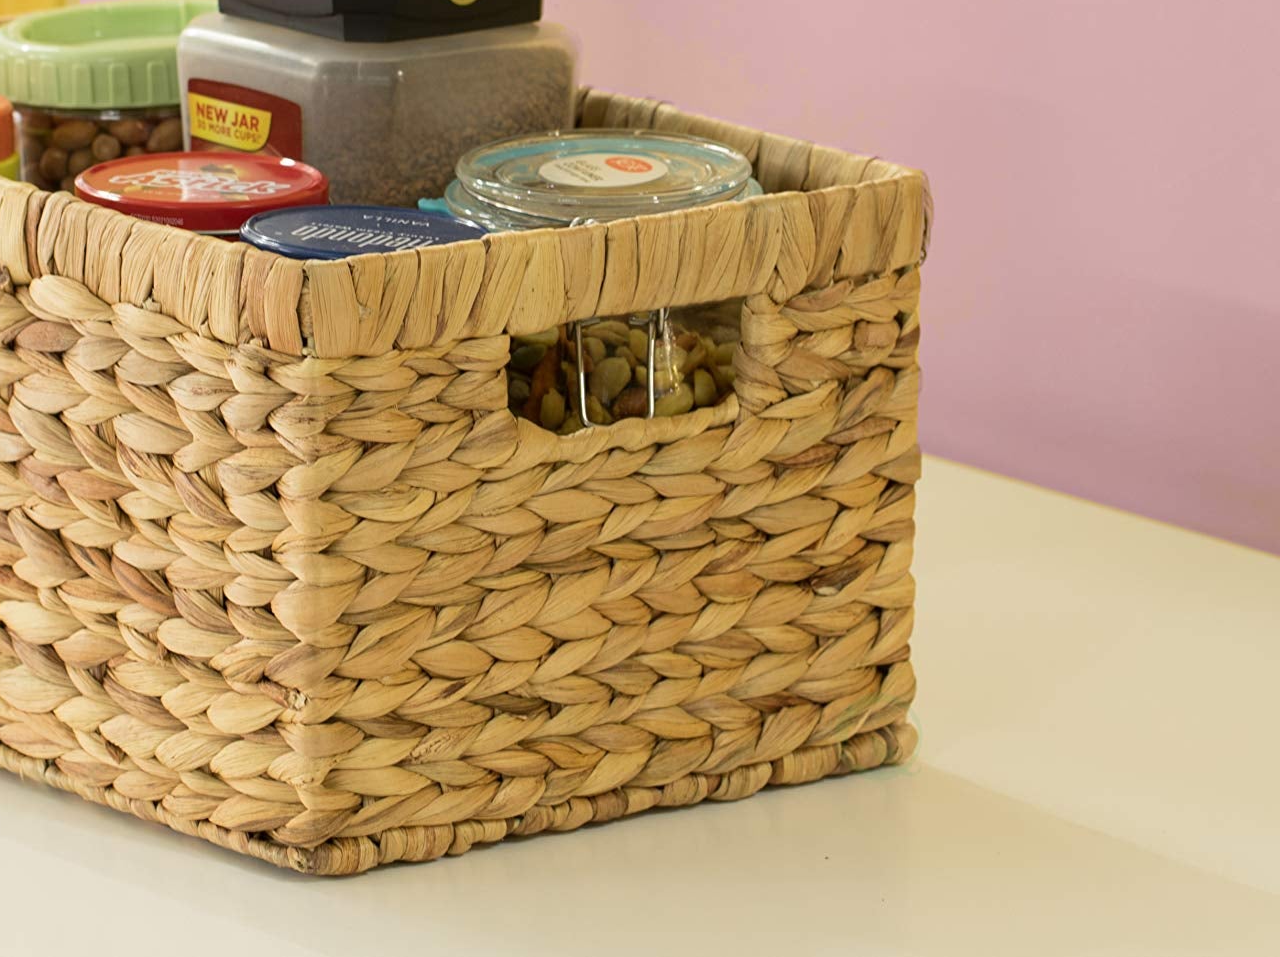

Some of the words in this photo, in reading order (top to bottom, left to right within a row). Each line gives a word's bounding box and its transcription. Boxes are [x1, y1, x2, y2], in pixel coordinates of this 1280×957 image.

[195, 101, 228, 123] NEW
[231, 112, 260, 133] JAR
[208, 122, 231, 138] MORE
[363, 214, 430, 227] VANILLA
